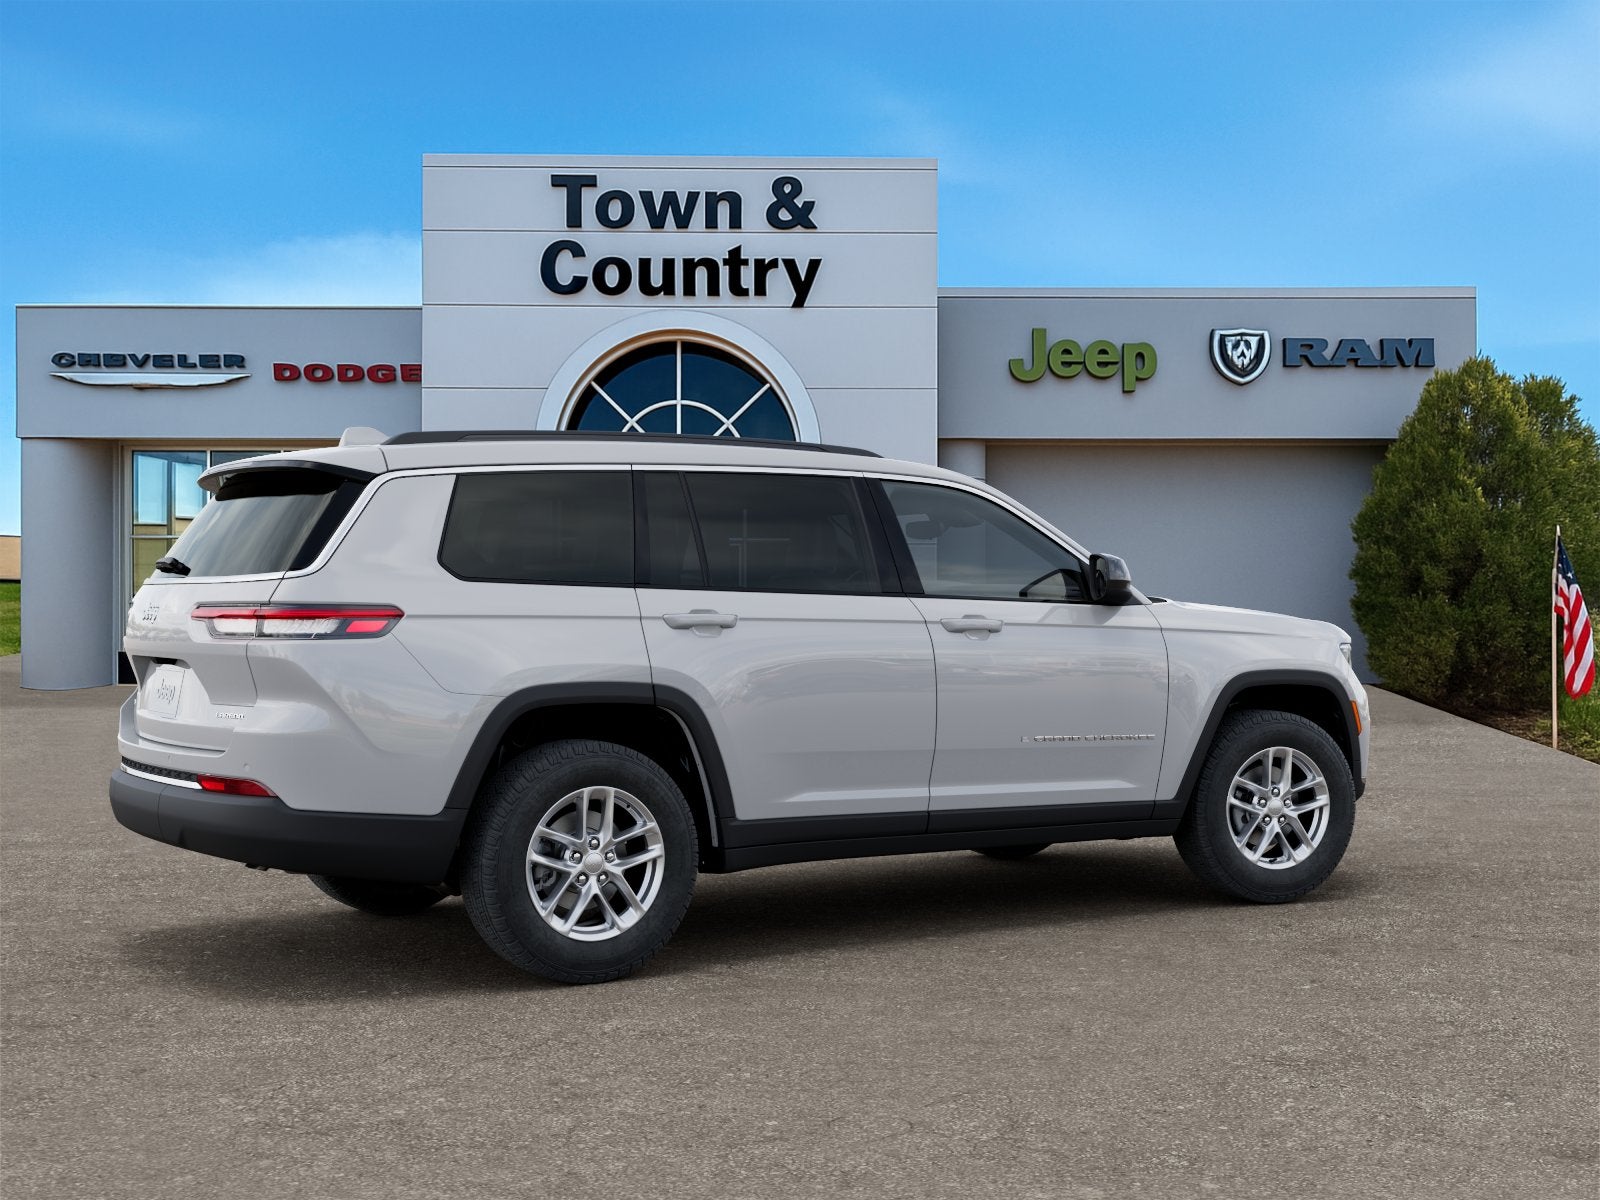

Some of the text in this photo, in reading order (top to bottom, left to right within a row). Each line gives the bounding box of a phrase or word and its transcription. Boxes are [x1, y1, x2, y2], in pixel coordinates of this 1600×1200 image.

[550, 174, 818, 230] Town &
[540, 239, 823, 308] Country
[272, 363, 422, 383] DODGE
[1008, 328, 1158, 393] Jeep
[1282, 337, 1436, 368] RAM
